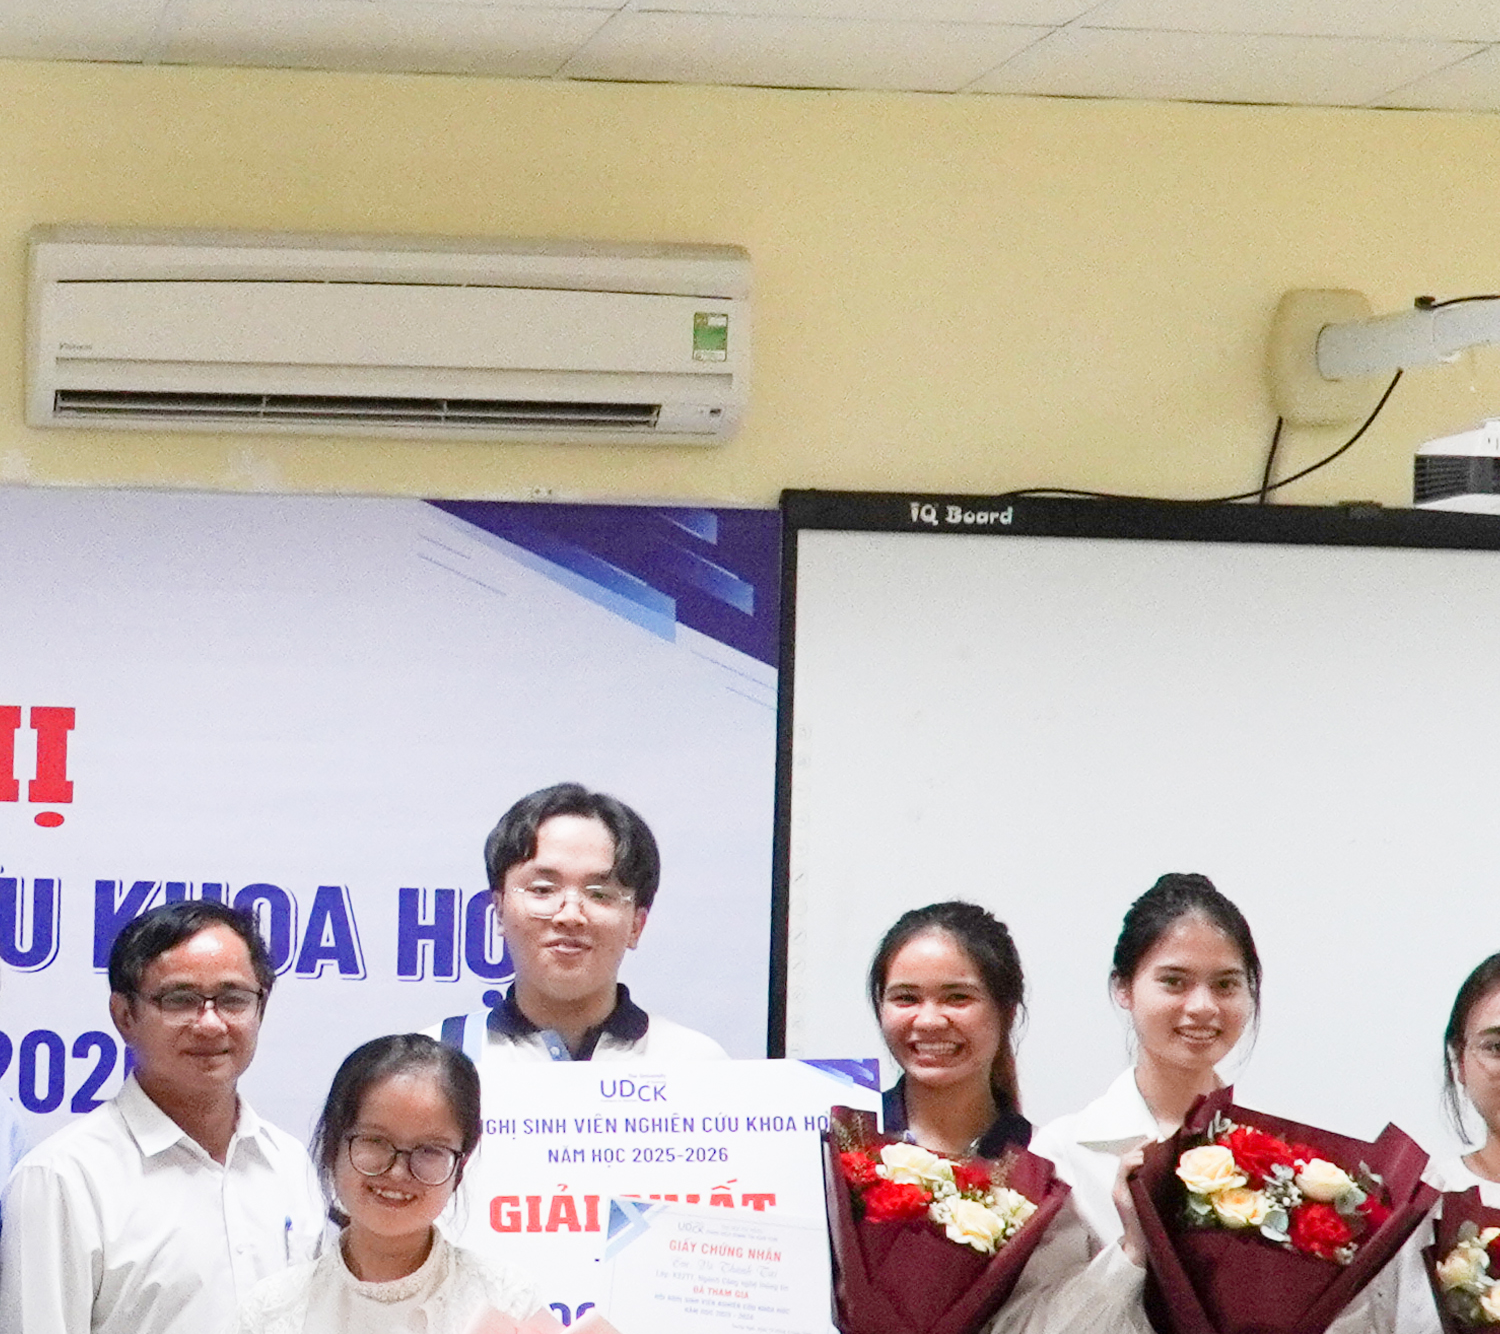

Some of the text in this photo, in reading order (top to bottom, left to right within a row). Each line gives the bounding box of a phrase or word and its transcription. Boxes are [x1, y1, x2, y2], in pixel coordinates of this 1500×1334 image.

[945, 505, 1013, 525] Board
[600, 1079, 667, 1102] UDCK
[482, 1119, 516, 1140] GHỊ
[523, 1118, 566, 1135] SINH
[574, 1112, 617, 1134] VIÊN
[625, 1113, 694, 1133] NGHIÊN
[702, 1113, 739, 1133] CỨU
[746, 1116, 797, 1132] KHOA
[548, 1147, 728, 1168] NĂM HỌC 2025-2026
[490, 1184, 600, 1233] GIẢI
